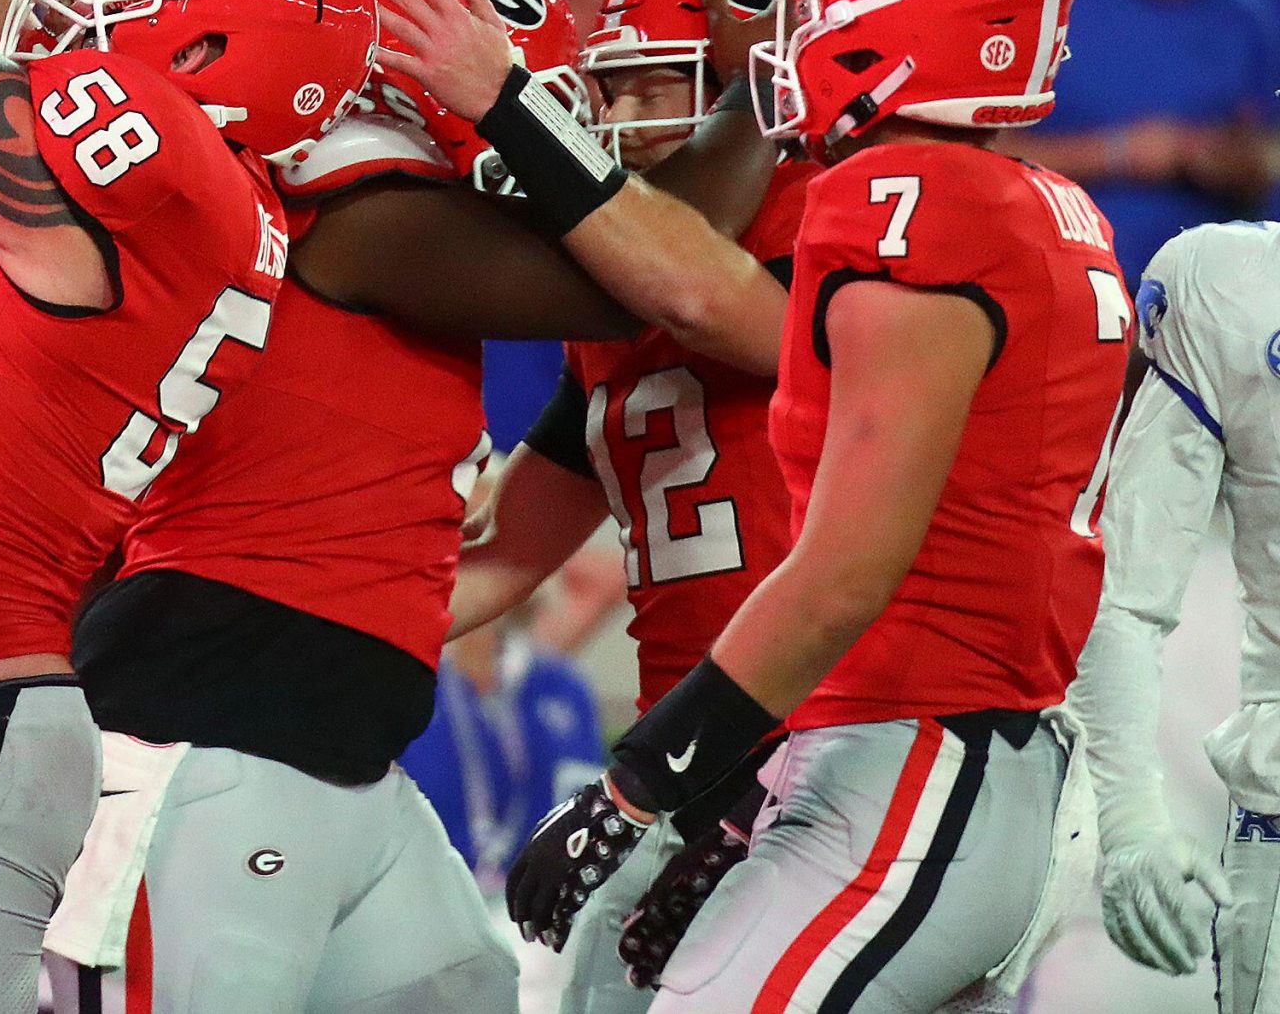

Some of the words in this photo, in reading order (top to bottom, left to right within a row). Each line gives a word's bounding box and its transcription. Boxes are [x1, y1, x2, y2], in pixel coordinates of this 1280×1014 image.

[985, 40, 1012, 67] SEC
[39, 66, 160, 187] 58
[296, 87, 321, 111] SEC
[870, 176, 921, 258] 7
[586, 366, 745, 589] 12
